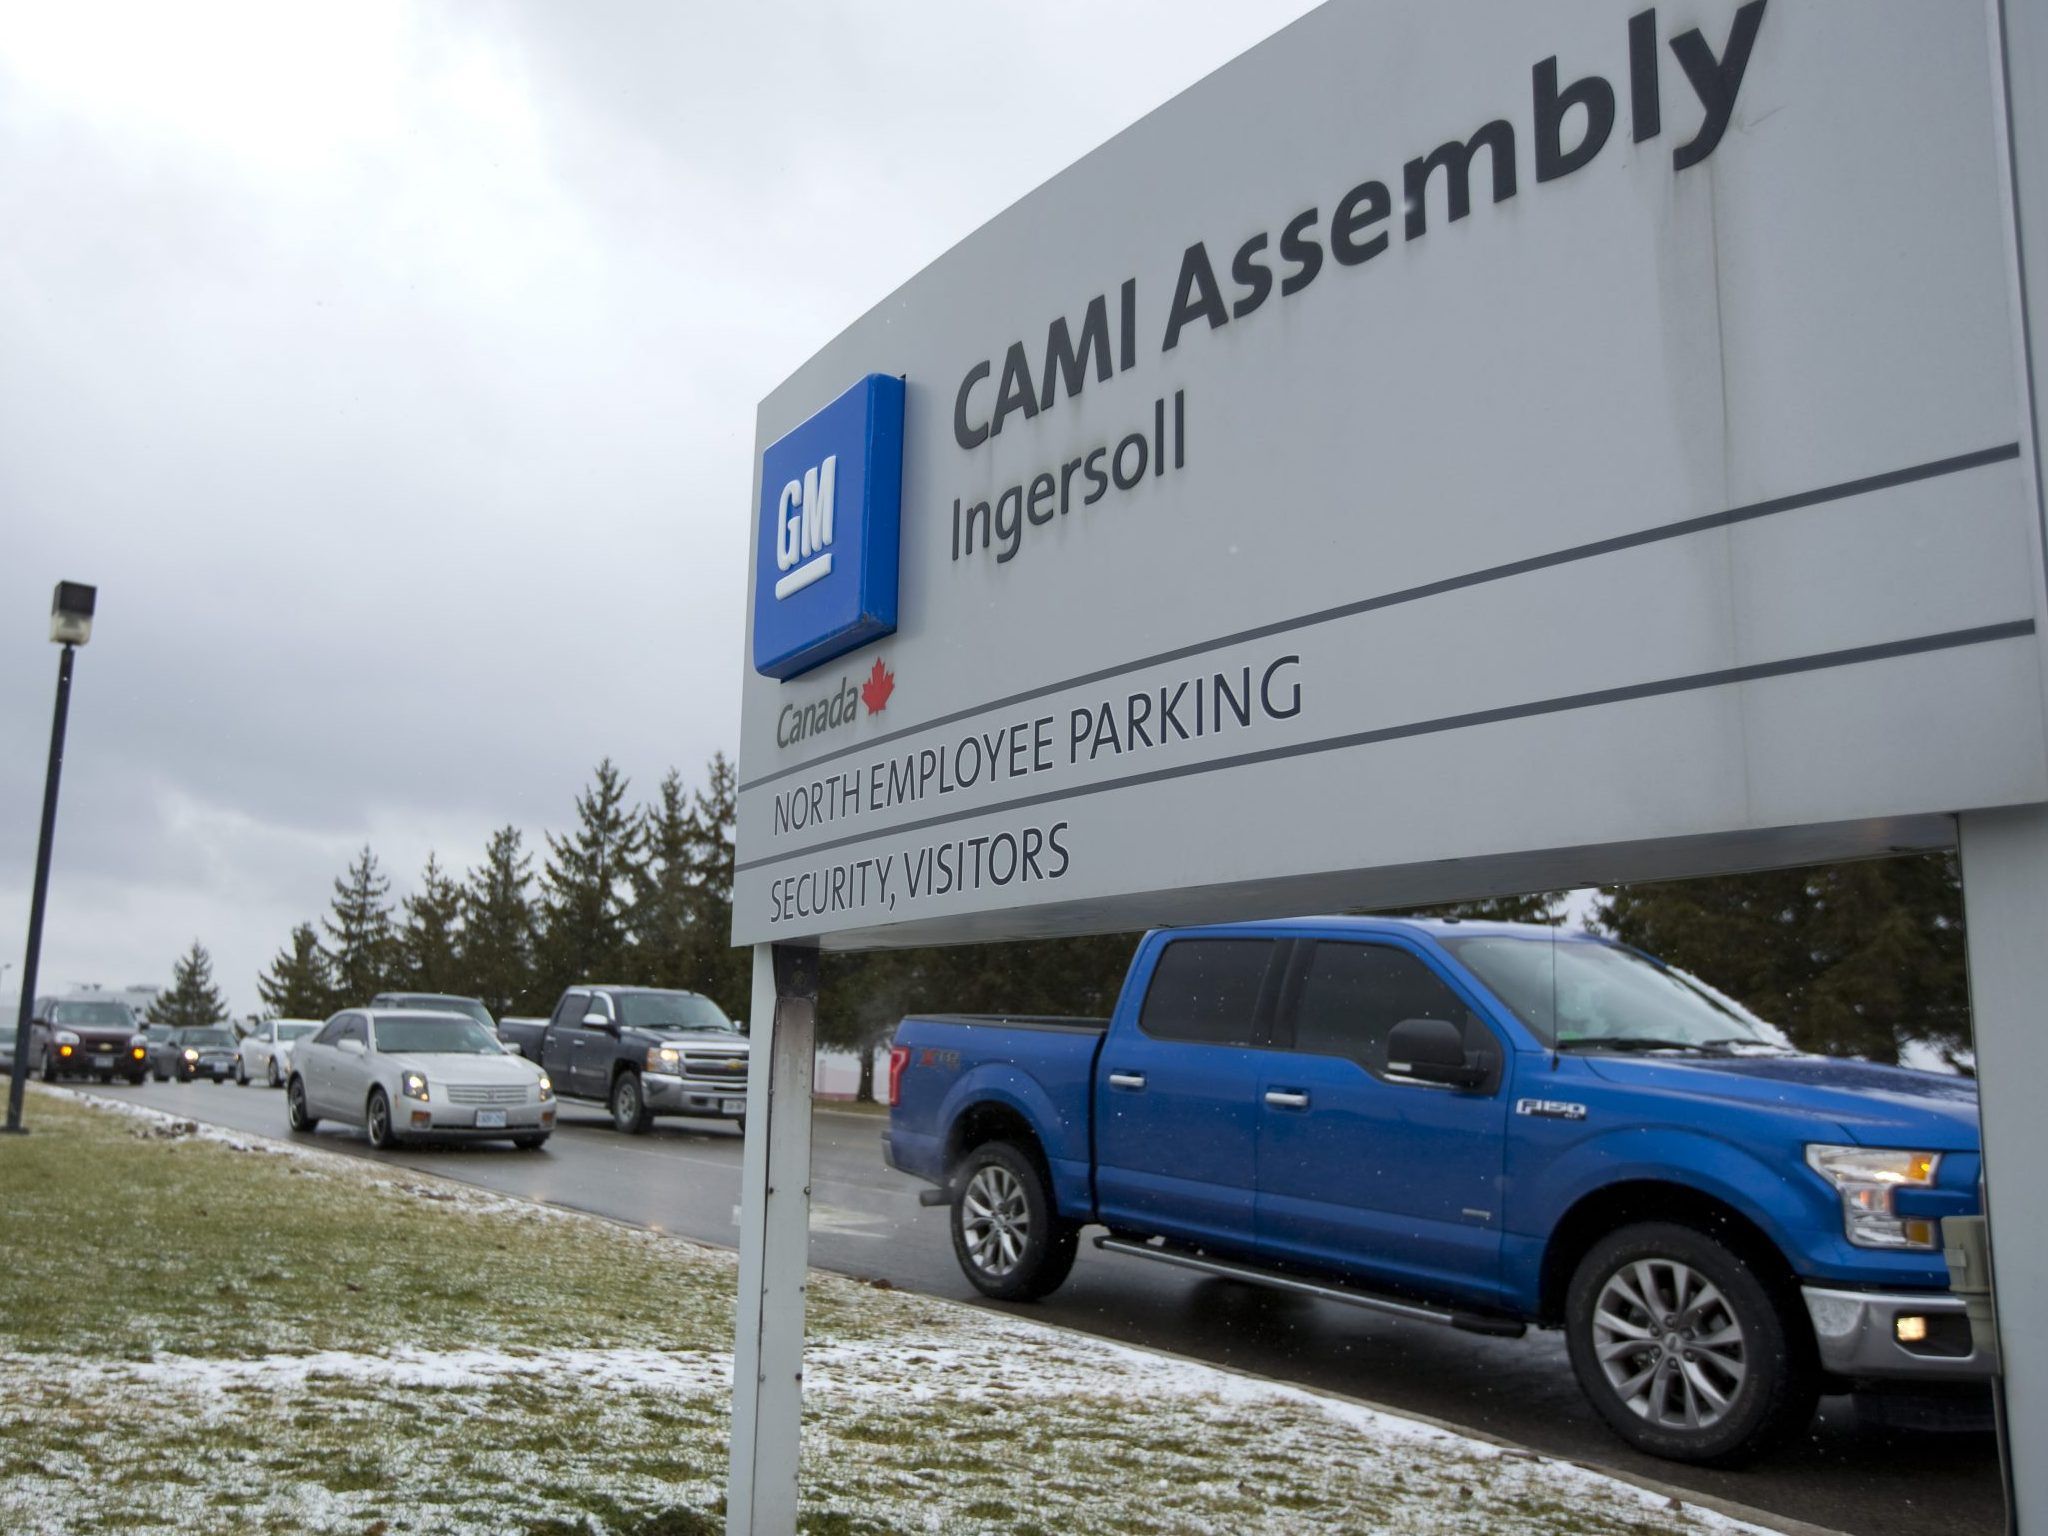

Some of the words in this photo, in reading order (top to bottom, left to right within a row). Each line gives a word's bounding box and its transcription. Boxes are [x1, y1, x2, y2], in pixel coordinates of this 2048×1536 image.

[953, 277, 1136, 449] CAMI
[1162, 0, 1767, 350] Assembly
[777, 454, 837, 571] GM
[952, 389, 1185, 564] Ingersoll
[774, 768, 861, 836] NORTH
[869, 716, 1054, 812] EMPLOYEE
[1070, 655, 1302, 764] PARKING
[776, 677, 859, 749] Canada
[770, 855, 897, 923] SECURITY,
[904, 821, 1070, 898] VISITORS
